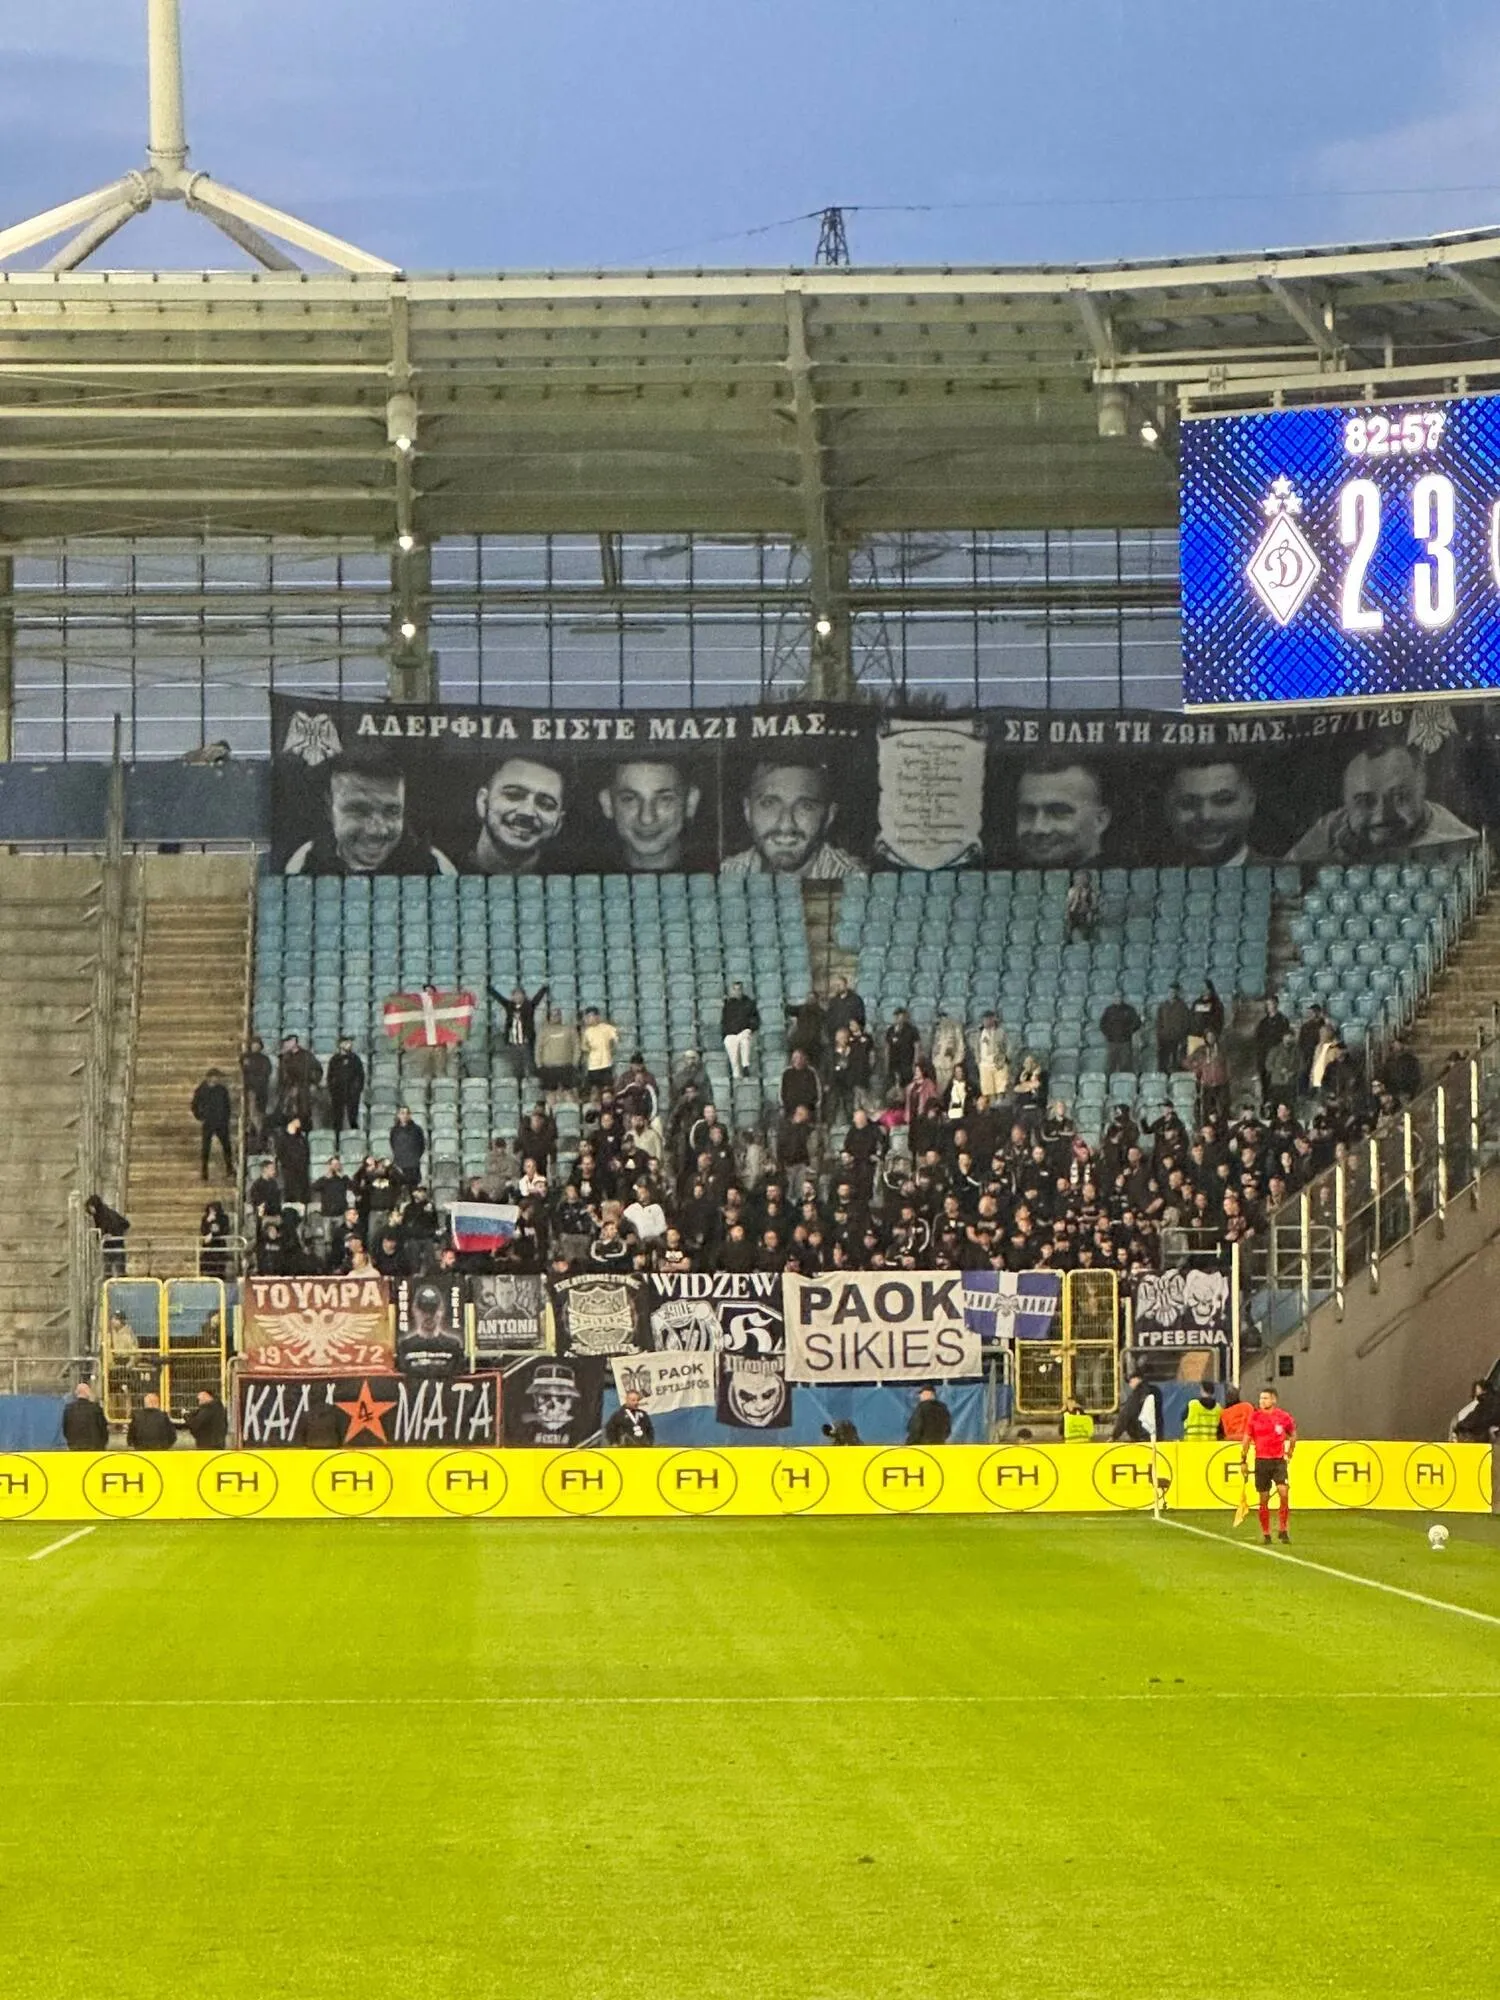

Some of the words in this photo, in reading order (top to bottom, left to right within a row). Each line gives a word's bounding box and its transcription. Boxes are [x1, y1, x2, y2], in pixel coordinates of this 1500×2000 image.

[1339, 477, 1385, 631] 2
[1411, 472, 1456, 627] 3
[356, 713, 518, 740] ΑΔΕΡΦΙΑ
[532, 717, 635, 740] ΕΙΣΤΕ
[648, 716, 737, 740] ΜΑΖΙ
[751, 712, 859, 738] ΜΑΣ...
[1004, 719, 1039, 743] ΣΕ
[1049, 720, 1105, 744] ΟΛΗ
[1115, 720, 1151, 743] ΤΗ
[1162, 722, 1216, 744] ΖΩΗ
[651, 1272, 780, 1298] WIDZEW
[800, 1278, 963, 1325] PAOK
[805, 1327, 965, 1372] SIKIES
[658, 1363, 704, 1380] PAOK
[101, 1472, 144, 1494] FH
[216, 1471, 259, 1492] FH
[331, 1470, 373, 1492] FH
[445, 1469, 488, 1490] FH
[560, 1469, 603, 1490] FH
[675, 1468, 718, 1489] FH
[882, 1466, 924, 1488] FH
[996, 1465, 1039, 1487] FH
[1333, 1461, 1371, 1483] FH
[1416, 1464, 1444, 1486] FH
